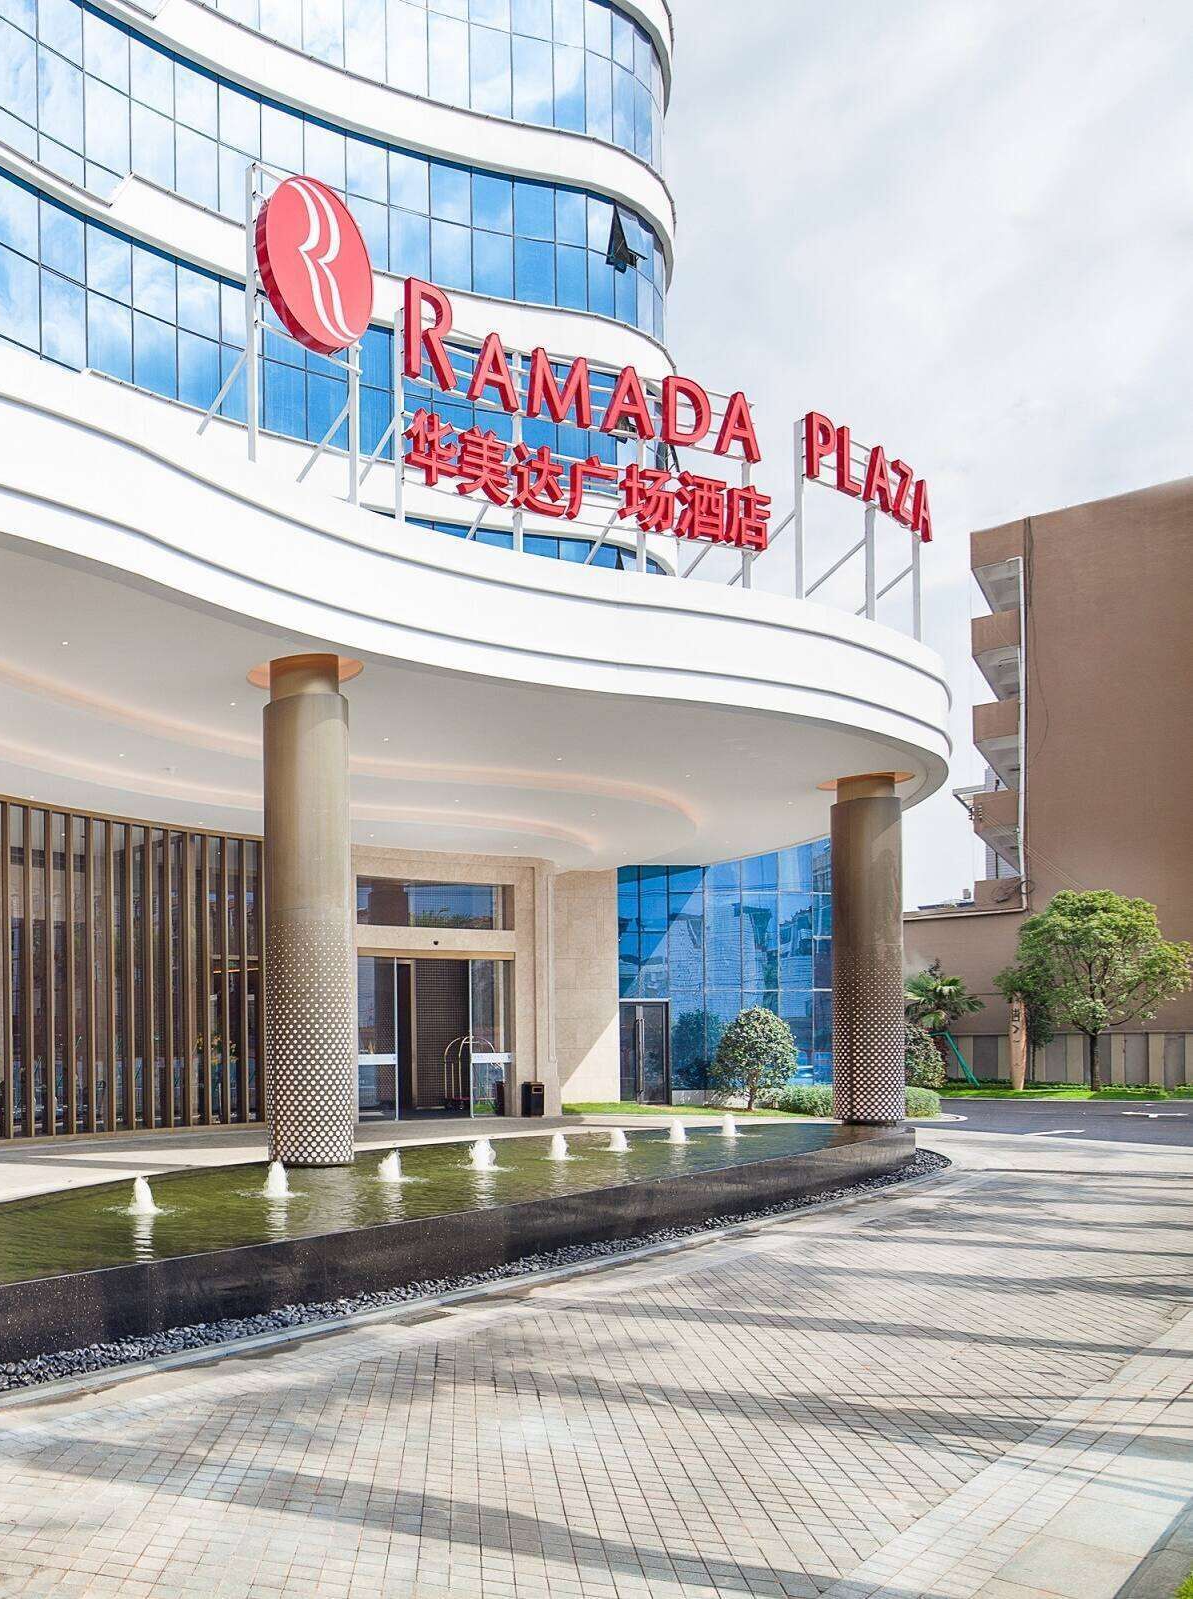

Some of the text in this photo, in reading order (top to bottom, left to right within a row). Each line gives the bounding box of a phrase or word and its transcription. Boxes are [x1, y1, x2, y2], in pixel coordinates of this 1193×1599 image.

[403, 277, 933, 543] RAMADA PLAZA
[403, 407, 771, 551] 华美达广场酒店
